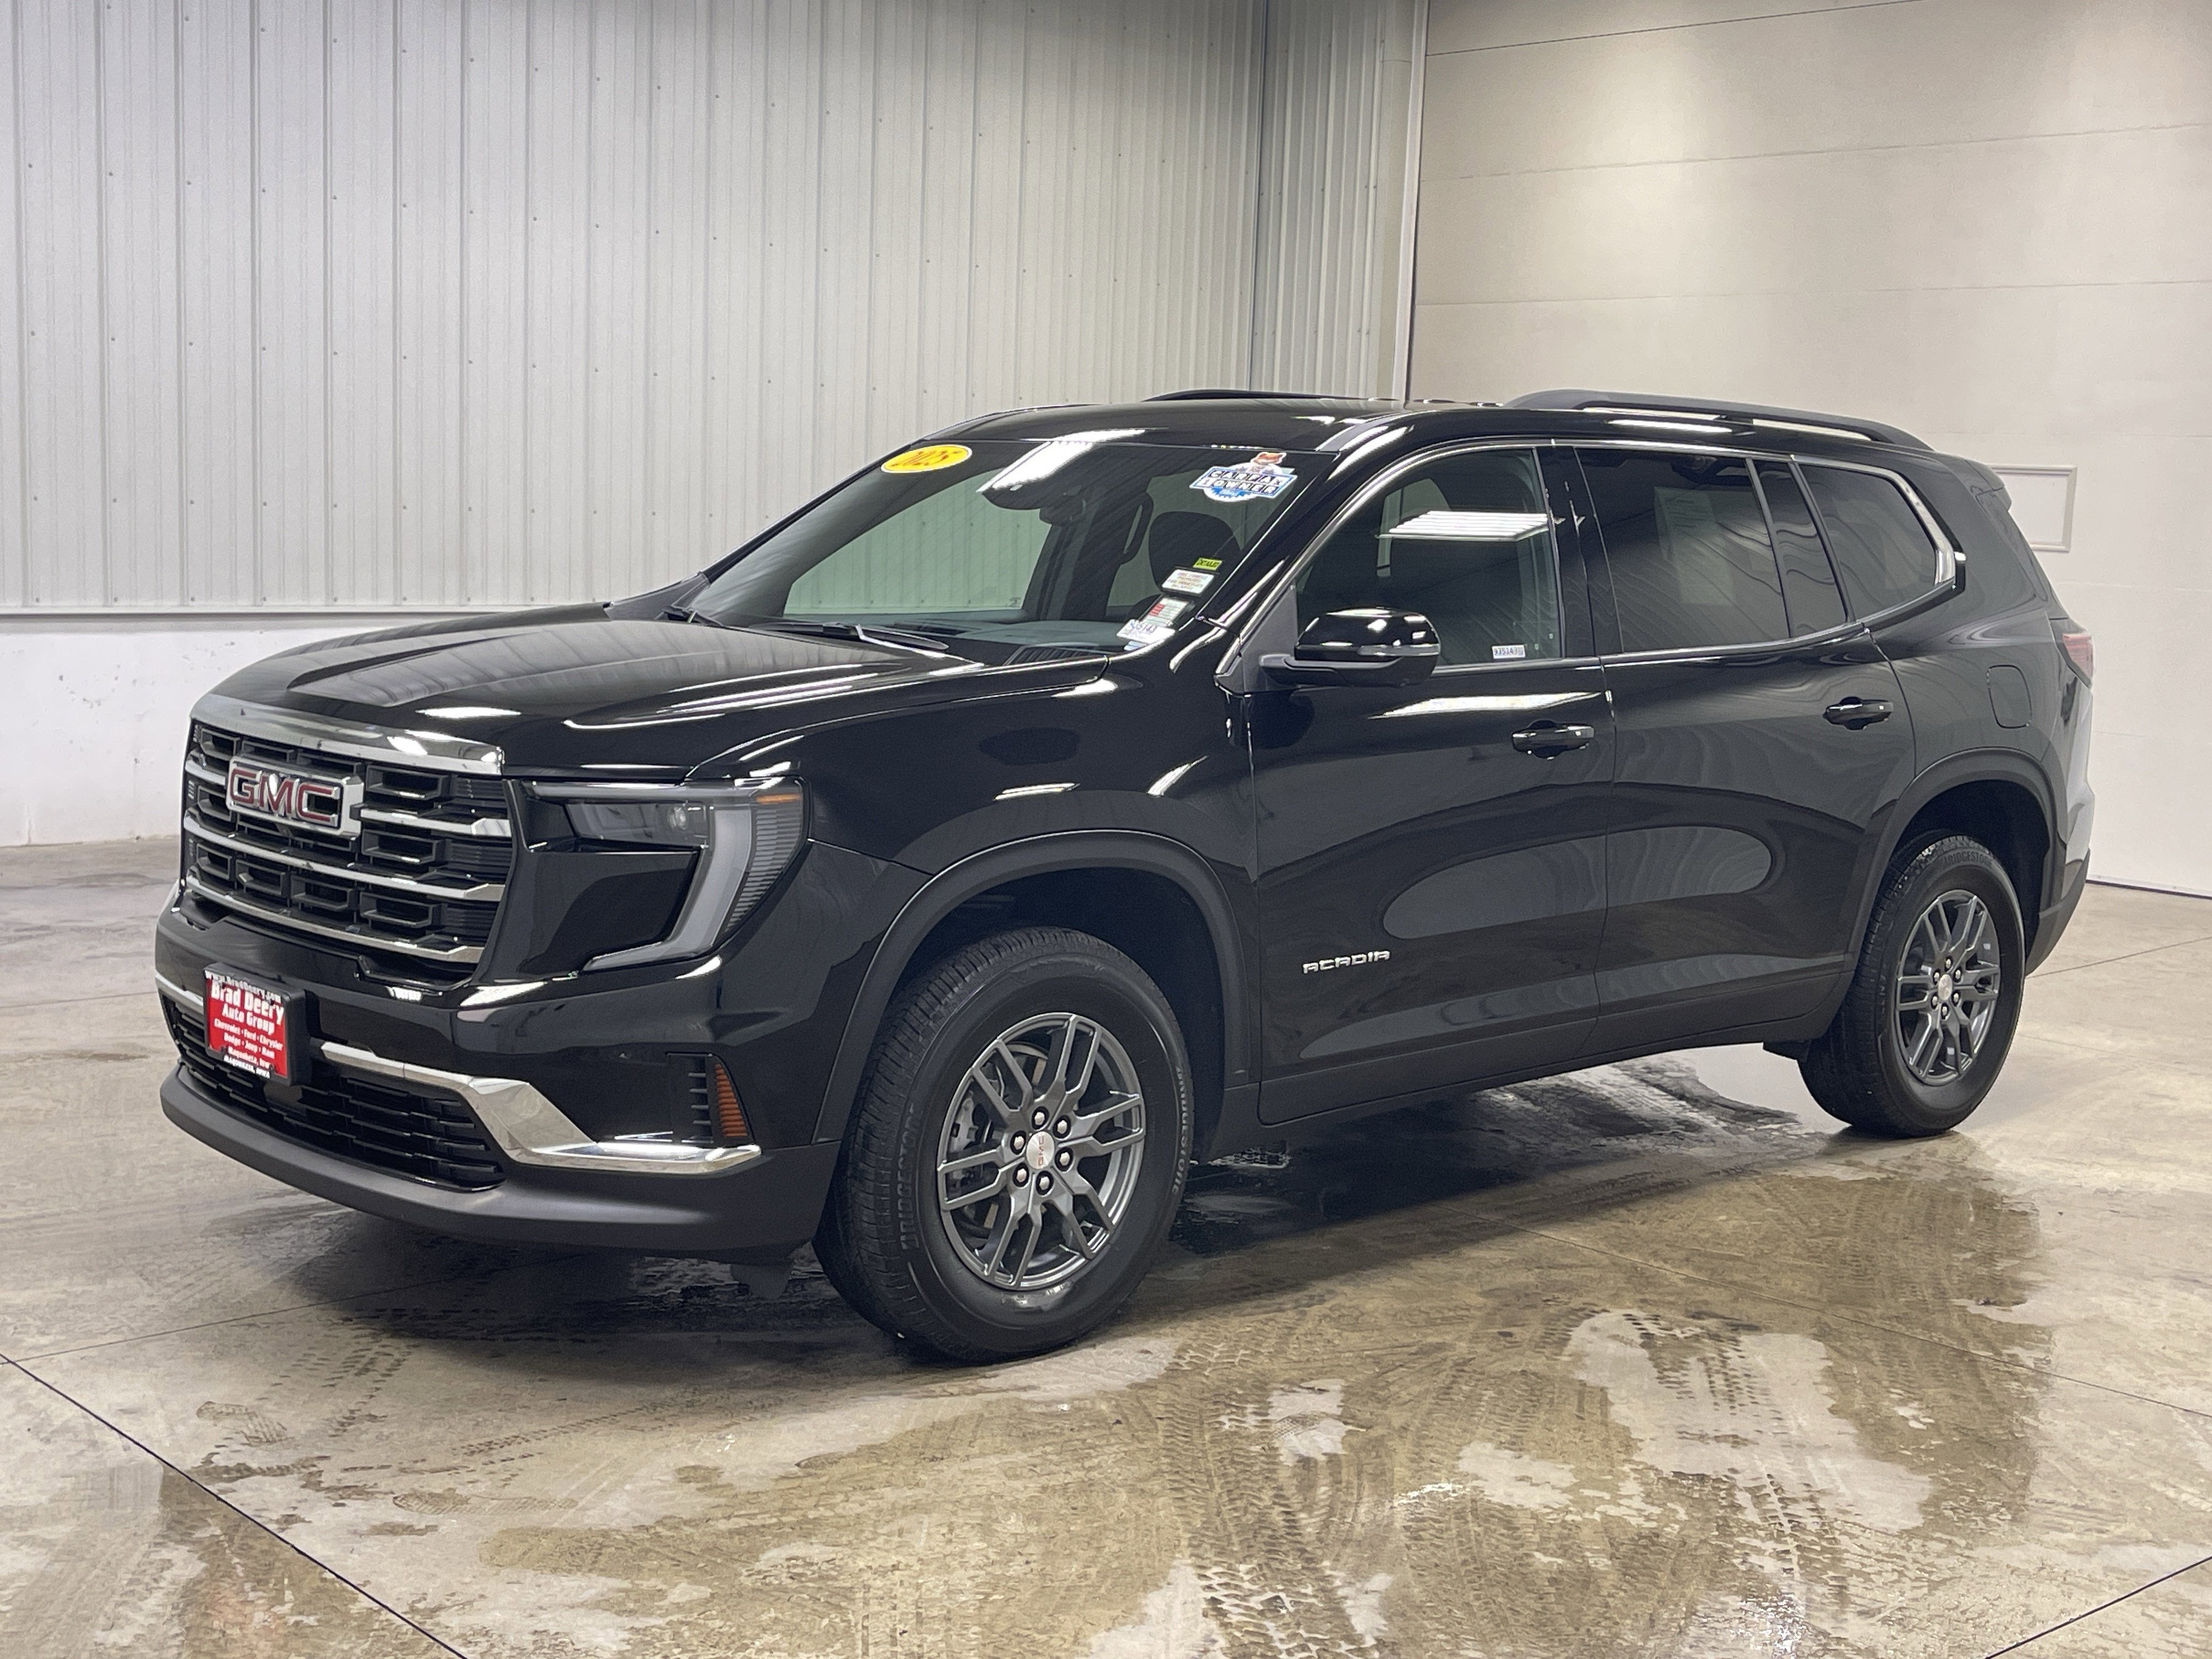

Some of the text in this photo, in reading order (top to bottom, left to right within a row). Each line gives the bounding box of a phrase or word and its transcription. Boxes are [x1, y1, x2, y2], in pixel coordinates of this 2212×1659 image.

[1210, 470, 1284, 486] CARFAX
[1214, 479, 1278, 493] OWNER
[229, 766, 340, 827] GMC
[1302, 950, 1390, 974] ACADIA
[211, 980, 284, 1025] Brad Deery
[222, 1003, 274, 1035] Auto Group
[244, 1028, 257, 1041] Ford
[259, 1034, 284, 1051] Chrysler
